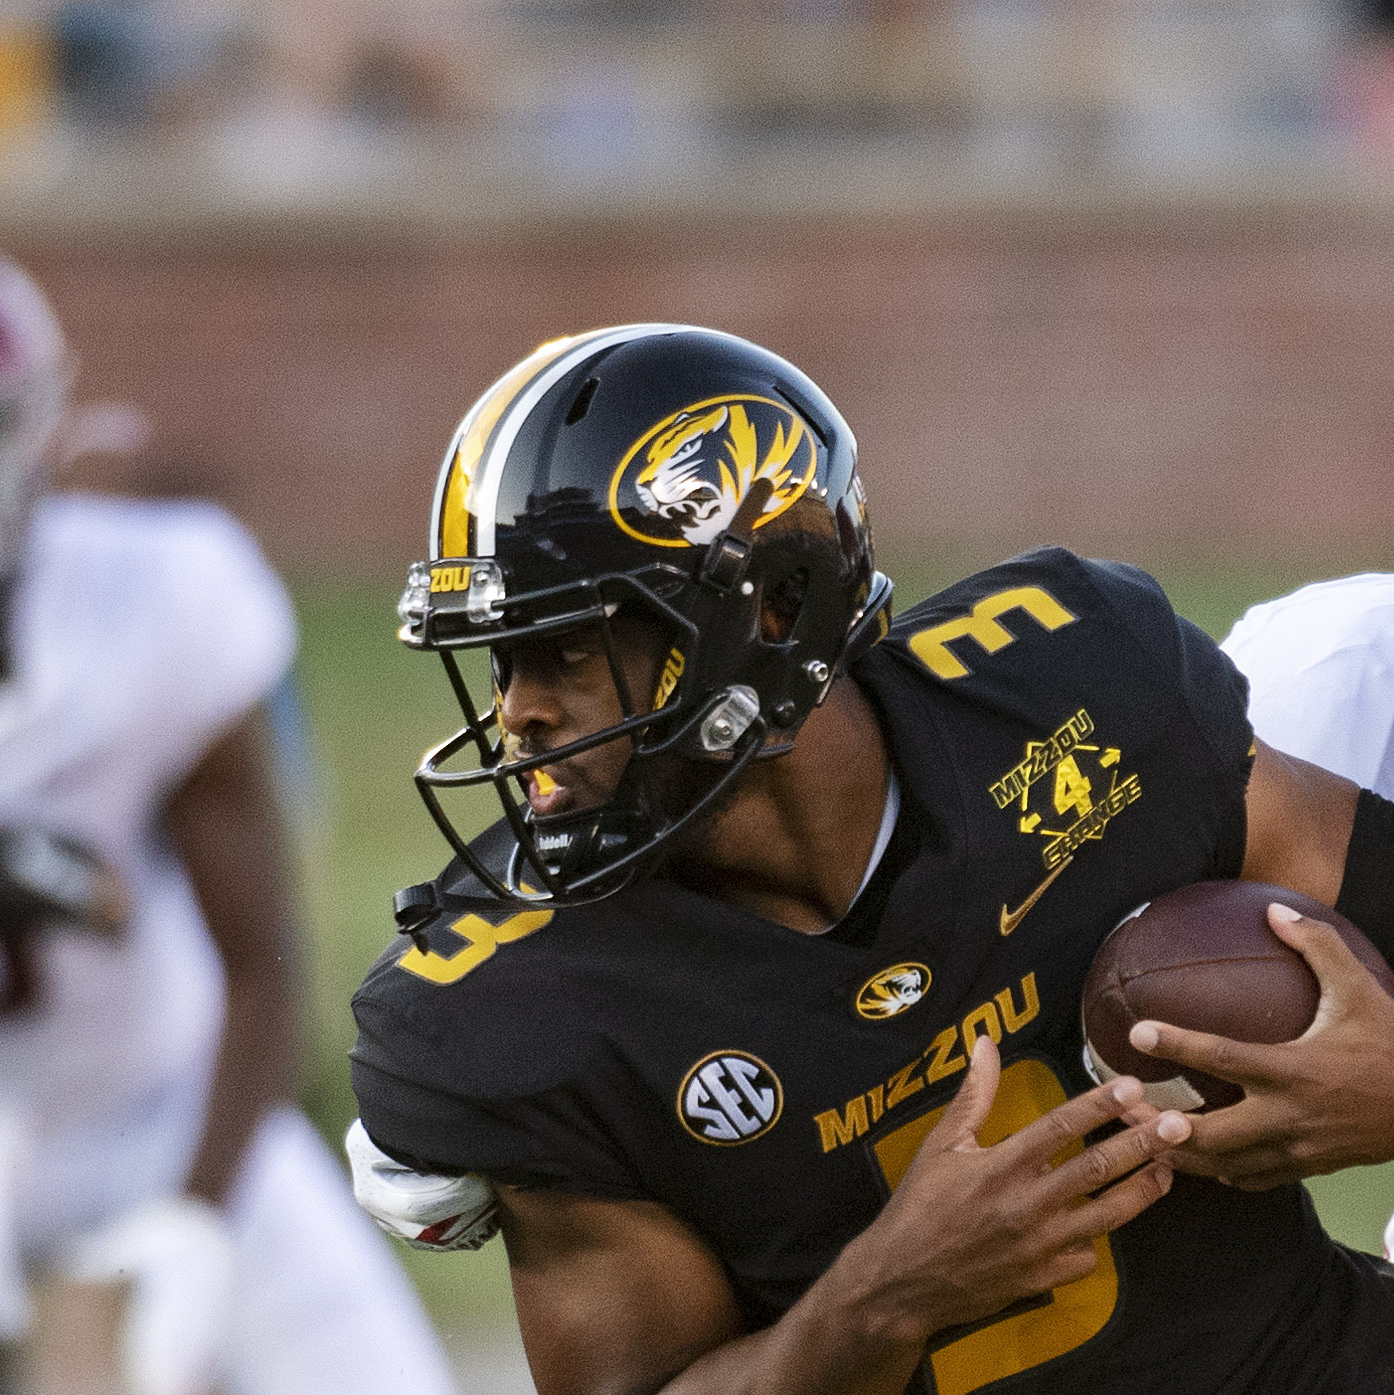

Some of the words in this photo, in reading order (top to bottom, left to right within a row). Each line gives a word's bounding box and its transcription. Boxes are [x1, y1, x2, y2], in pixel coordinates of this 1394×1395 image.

[430, 566, 471, 593] ZOU
[908, 585, 1079, 680] 3
[989, 707, 1096, 810] MIZZOU
[1054, 754, 1093, 818] 4
[685, 1057, 775, 1140] SEC
[813, 970, 1041, 1154] MIZZOU
